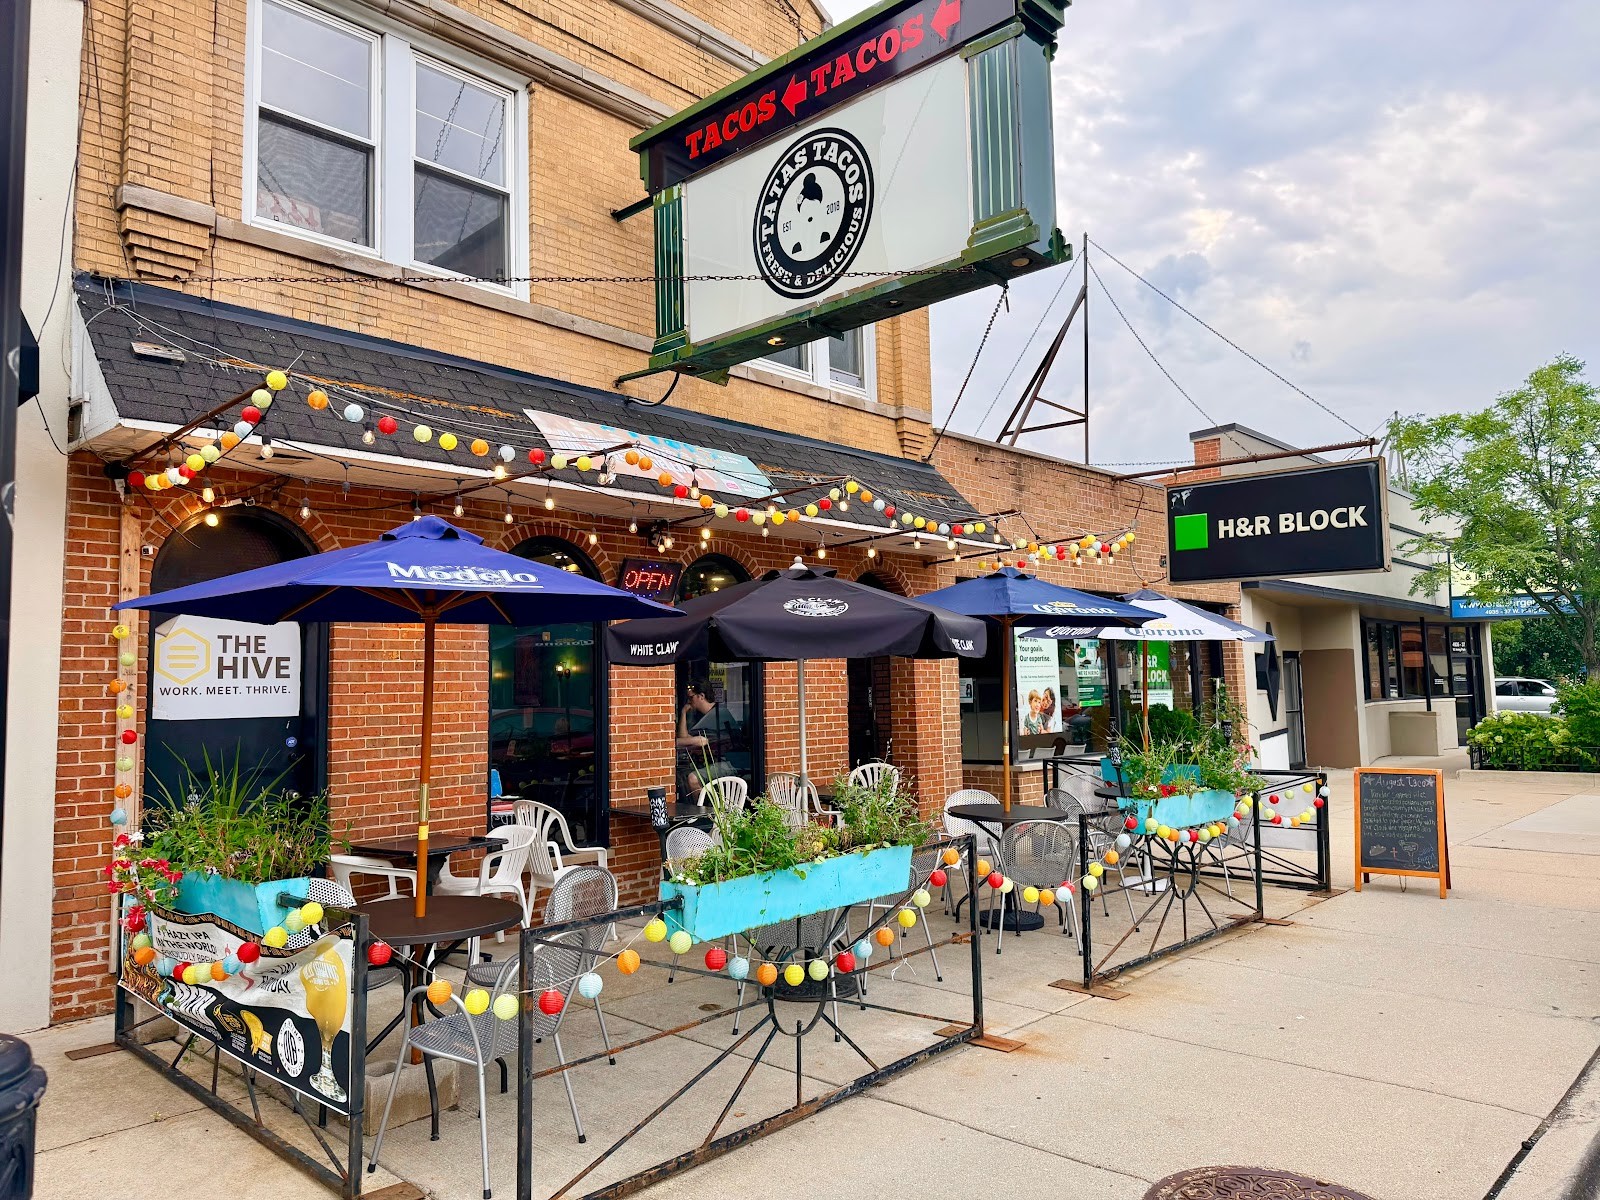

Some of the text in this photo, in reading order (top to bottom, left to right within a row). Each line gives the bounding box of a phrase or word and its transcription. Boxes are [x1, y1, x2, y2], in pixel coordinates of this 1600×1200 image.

[810, 13, 924, 97] TACOS
[685, 89, 777, 160] TACOS
[762, 140, 864, 241] TATAS TACOS
[782, 221, 792, 233] EST
[762, 207, 863, 287] FRESH & DELICIOUS
[1218, 505, 1368, 539] H&R BLOCK
[386, 561, 539, 583] Modelo
[1032, 603, 1118, 615] Corona
[1124, 626, 1204, 638] Corona
[217, 635, 267, 654] THE
[630, 641, 678, 656] WHITE CLAW
[217, 656, 291, 679] HIVE
[159, 685, 291, 696] WORK. MEET. THRIVE.
[156, 937, 165, 948] IN
[164, 939, 183, 949] THE
[167, 930, 191, 940] HAZY
[191, 931, 212, 941] IPA
